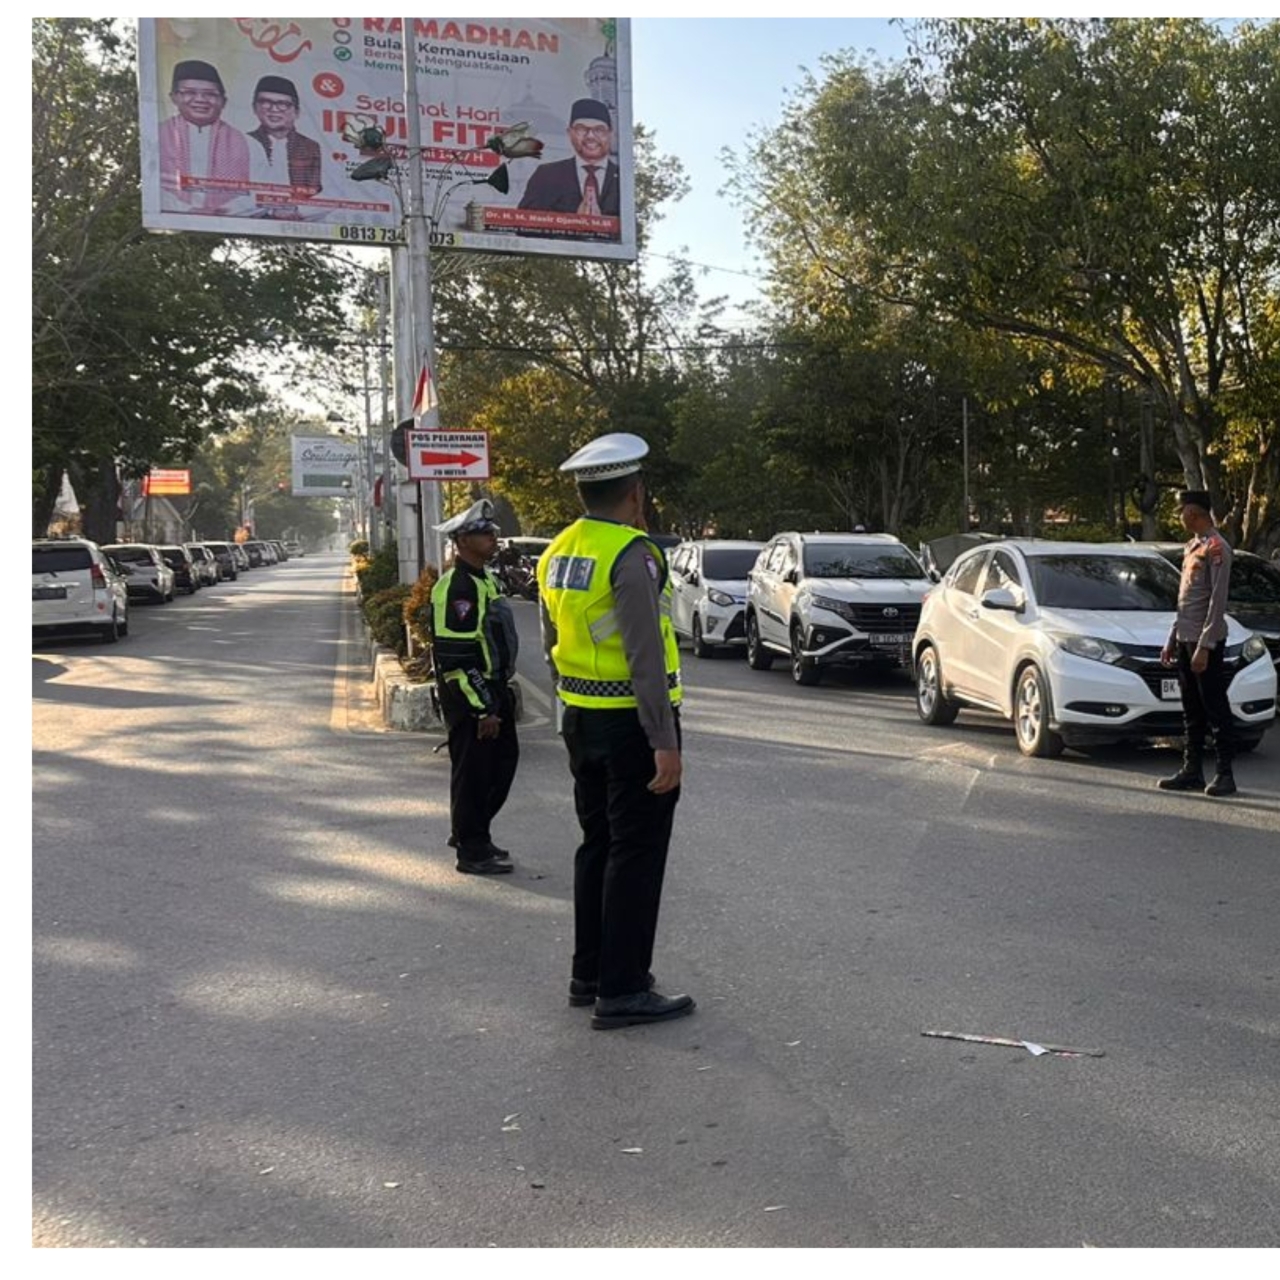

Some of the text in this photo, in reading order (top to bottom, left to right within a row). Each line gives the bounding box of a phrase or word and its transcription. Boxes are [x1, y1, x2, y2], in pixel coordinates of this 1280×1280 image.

[363, 35, 530, 65] Bula Kemanusiaan
[424, 54, 513, 74] Menguatkan,
[456, 105, 500, 122] Hari
[472, 152, 484, 163] H
[339, 225, 376, 241] 0813
[411, 433, 485, 442] POS PELAYANAN
[1163, 681, 1175, 693] BK
